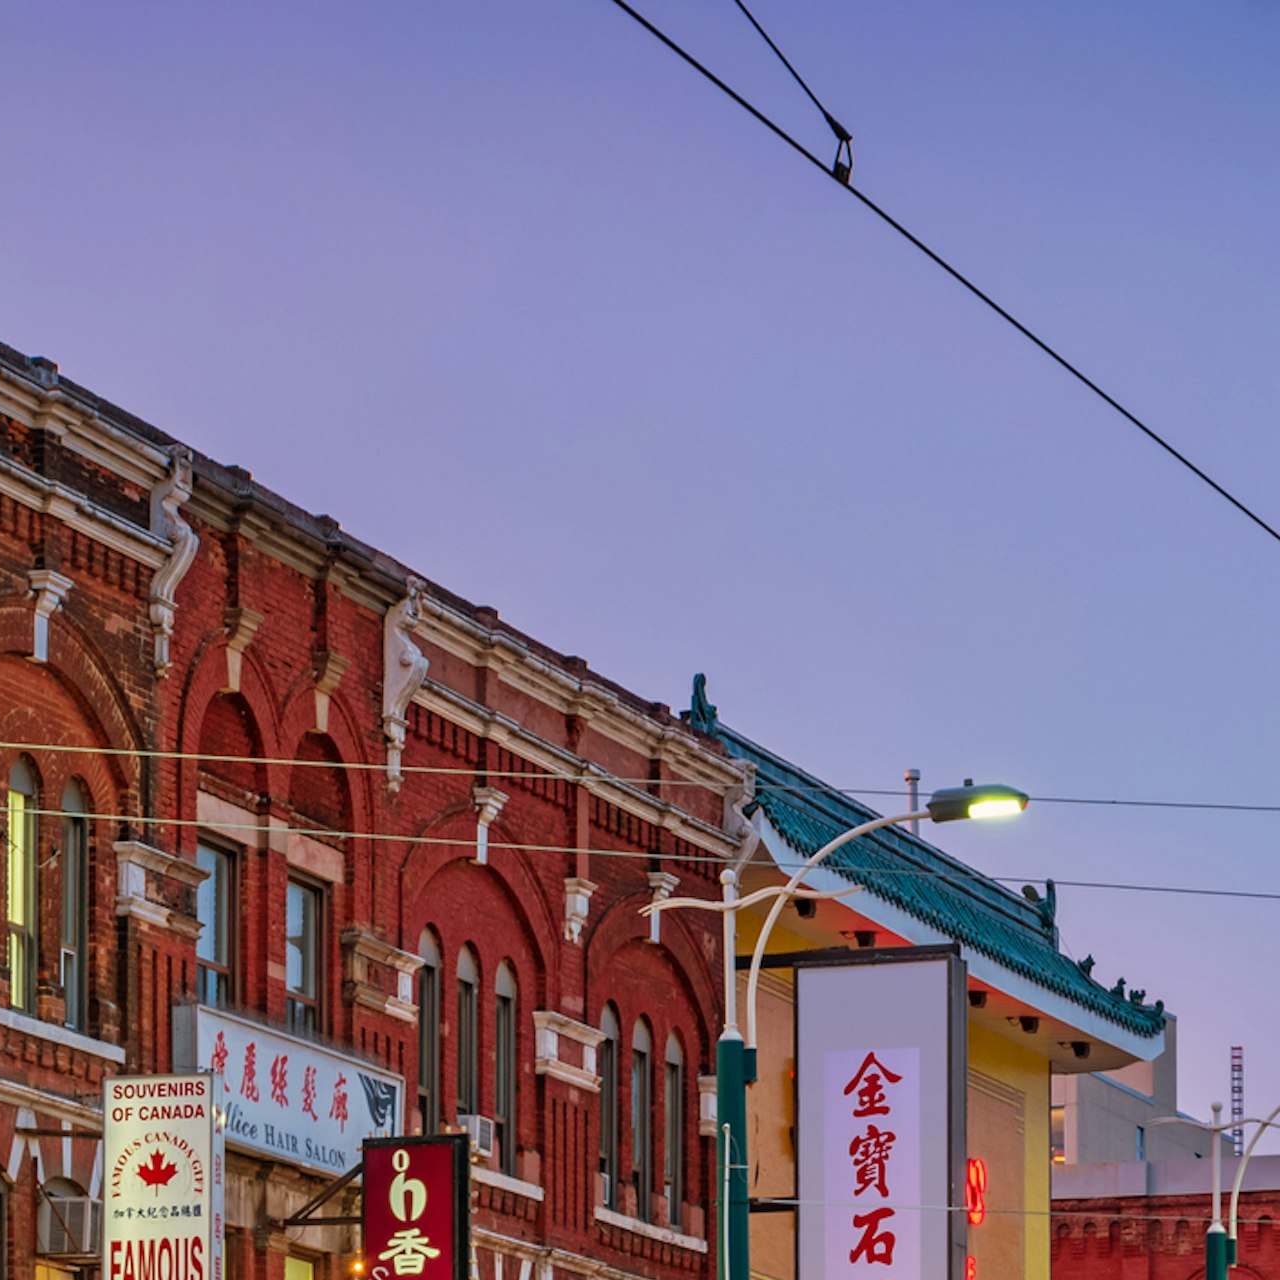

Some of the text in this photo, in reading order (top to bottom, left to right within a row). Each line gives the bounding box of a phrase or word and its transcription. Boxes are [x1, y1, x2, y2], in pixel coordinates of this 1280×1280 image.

[112, 1081, 206, 1100] SOUVENIRS
[112, 1104, 206, 1122] OF CANADA
[112, 1131, 204, 1199] FAMOUS CANADA GIFT
